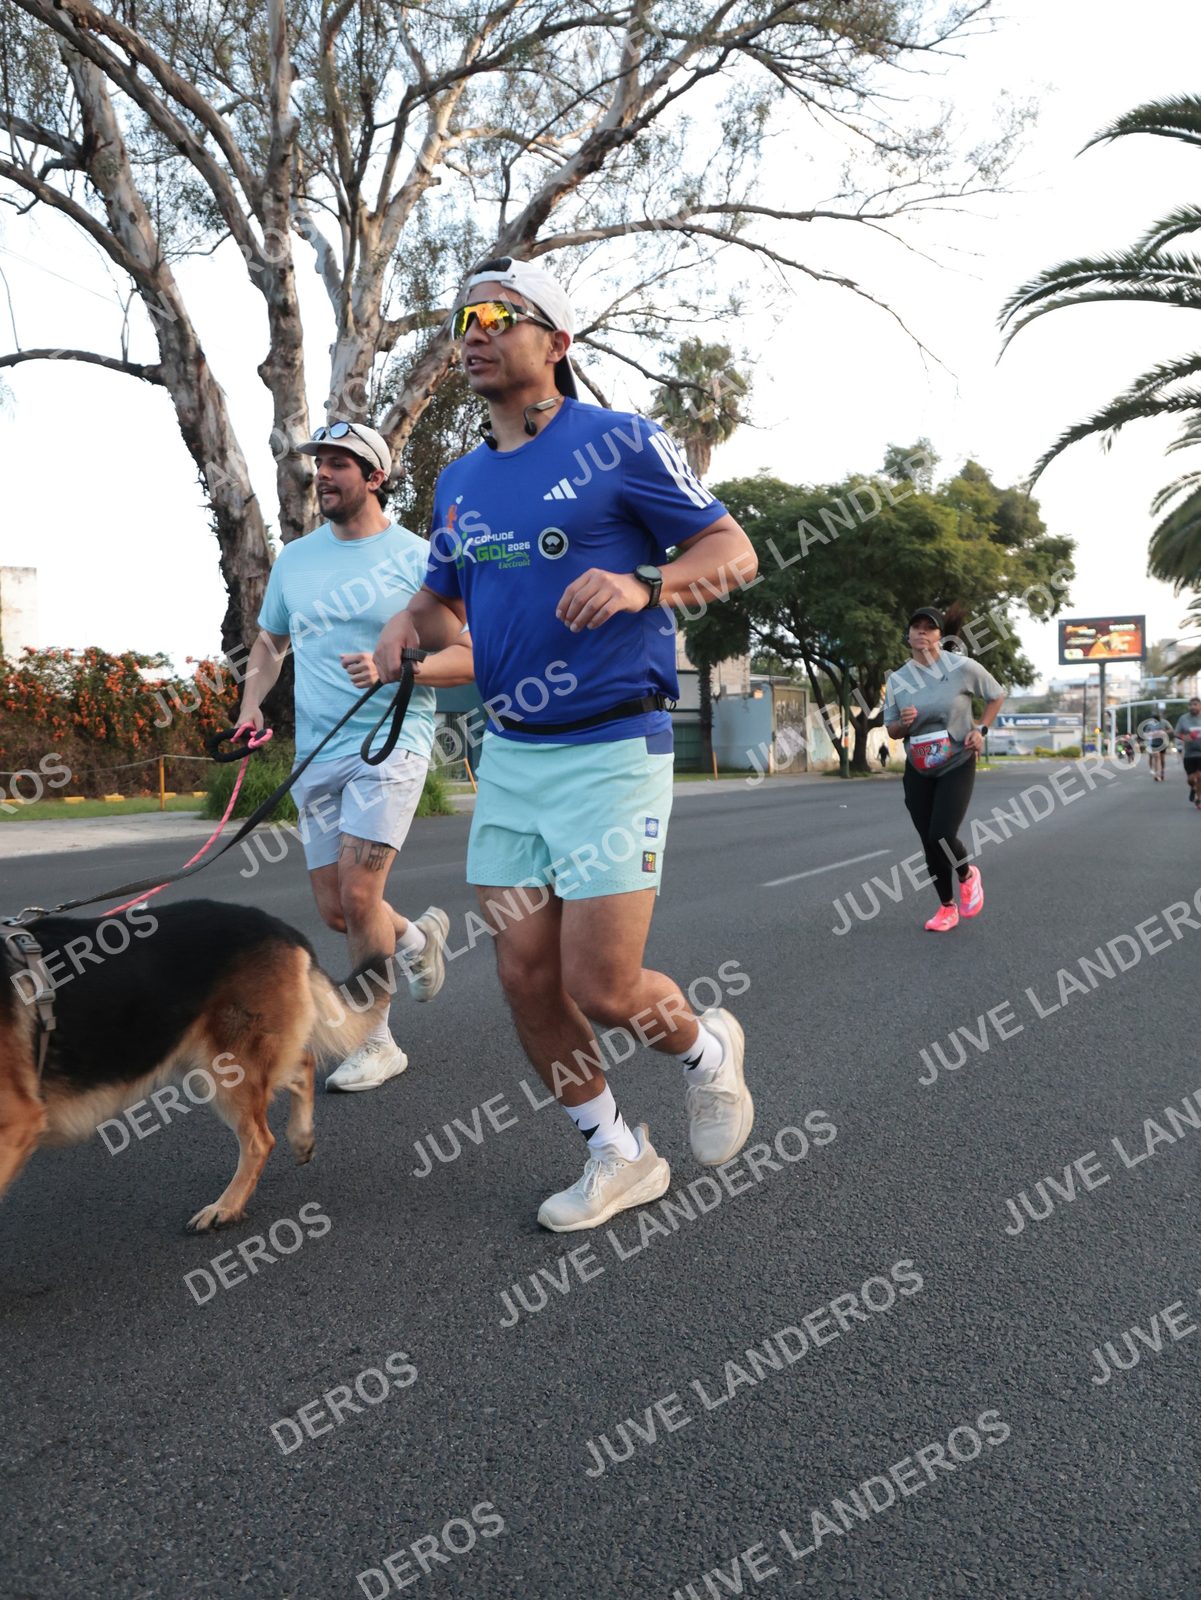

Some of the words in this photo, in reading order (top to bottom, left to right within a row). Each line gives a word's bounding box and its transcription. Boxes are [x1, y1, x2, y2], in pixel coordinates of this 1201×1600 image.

[474, 531, 514, 544] COMUDE
[476, 544, 509, 561] GDL
[507, 541, 531, 552] 2026
